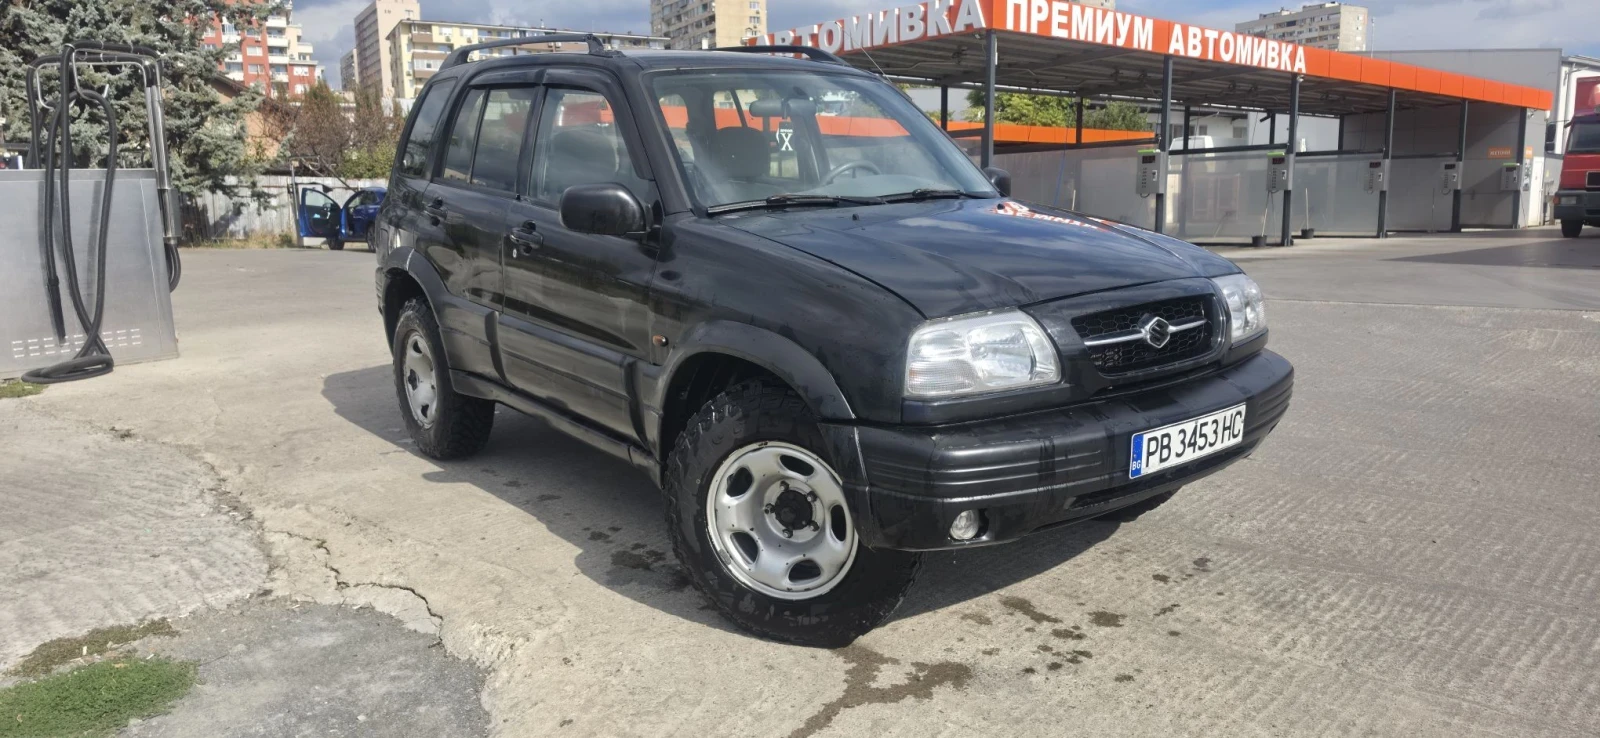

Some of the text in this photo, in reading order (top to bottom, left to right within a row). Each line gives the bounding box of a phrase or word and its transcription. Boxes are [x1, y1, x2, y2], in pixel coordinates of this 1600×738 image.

[1006, 0, 1306, 73] ПРЕМИУМ АВТОМИВКА
[1175, 418, 1218, 458] 3453
[1132, 460, 1141, 470] BG
